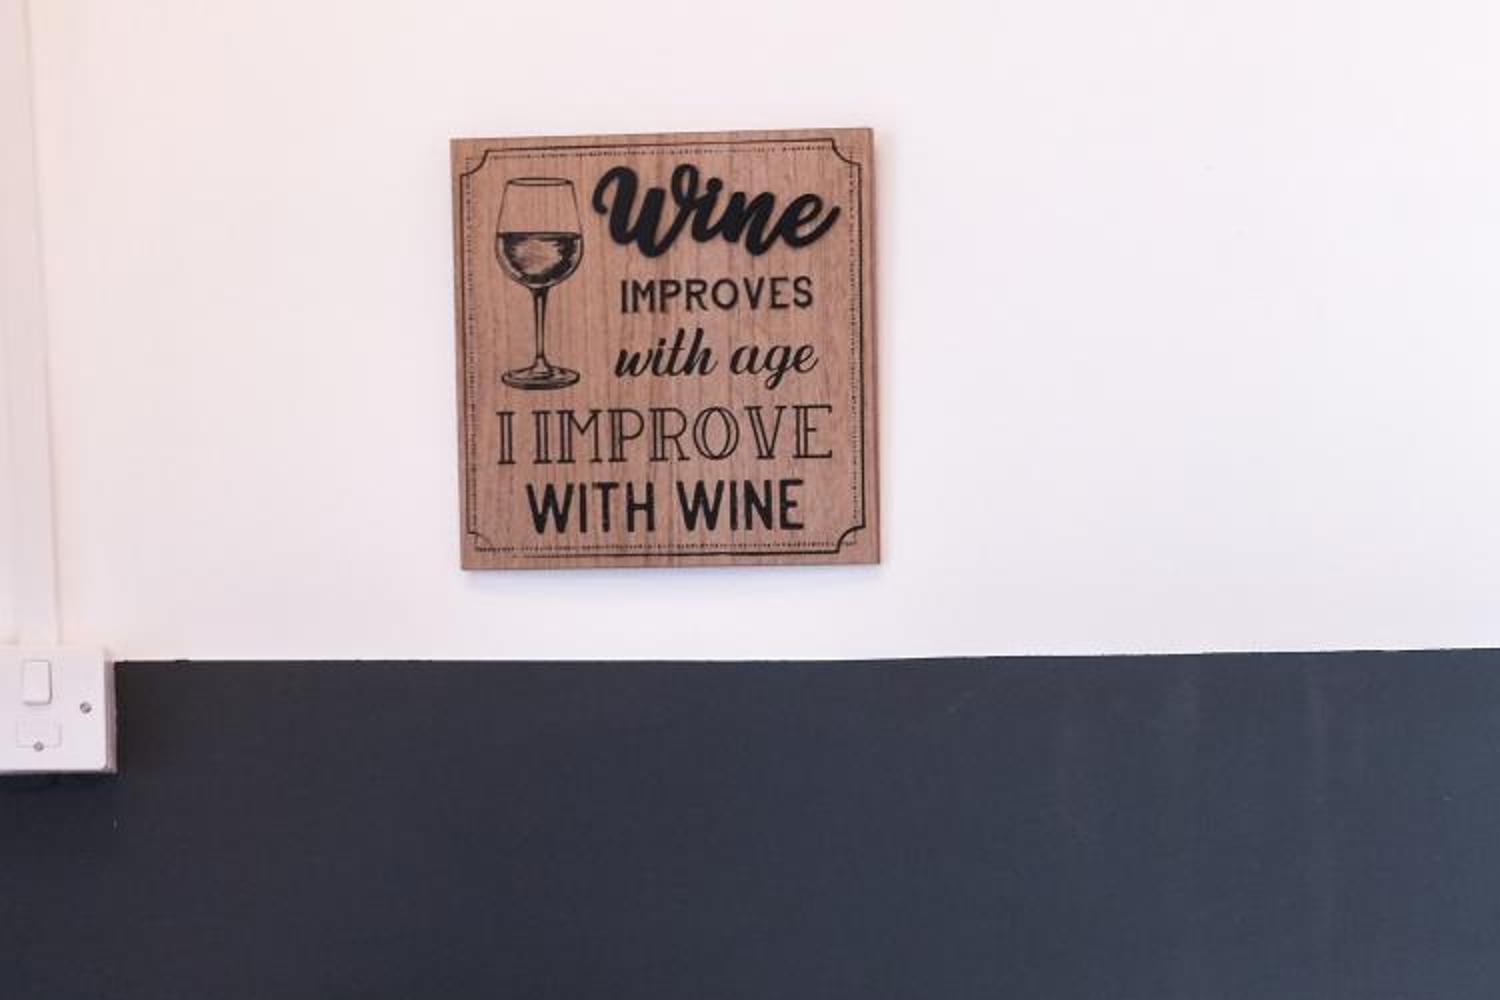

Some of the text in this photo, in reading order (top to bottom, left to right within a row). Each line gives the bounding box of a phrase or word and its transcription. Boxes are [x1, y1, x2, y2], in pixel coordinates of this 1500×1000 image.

[593, 163, 841, 257] Wine
[621, 277, 813, 313] IMPROVES
[615, 328, 818, 390] with age
[496, 405, 833, 465] I IMPROVE
[526, 478, 804, 534] WITH WINE
